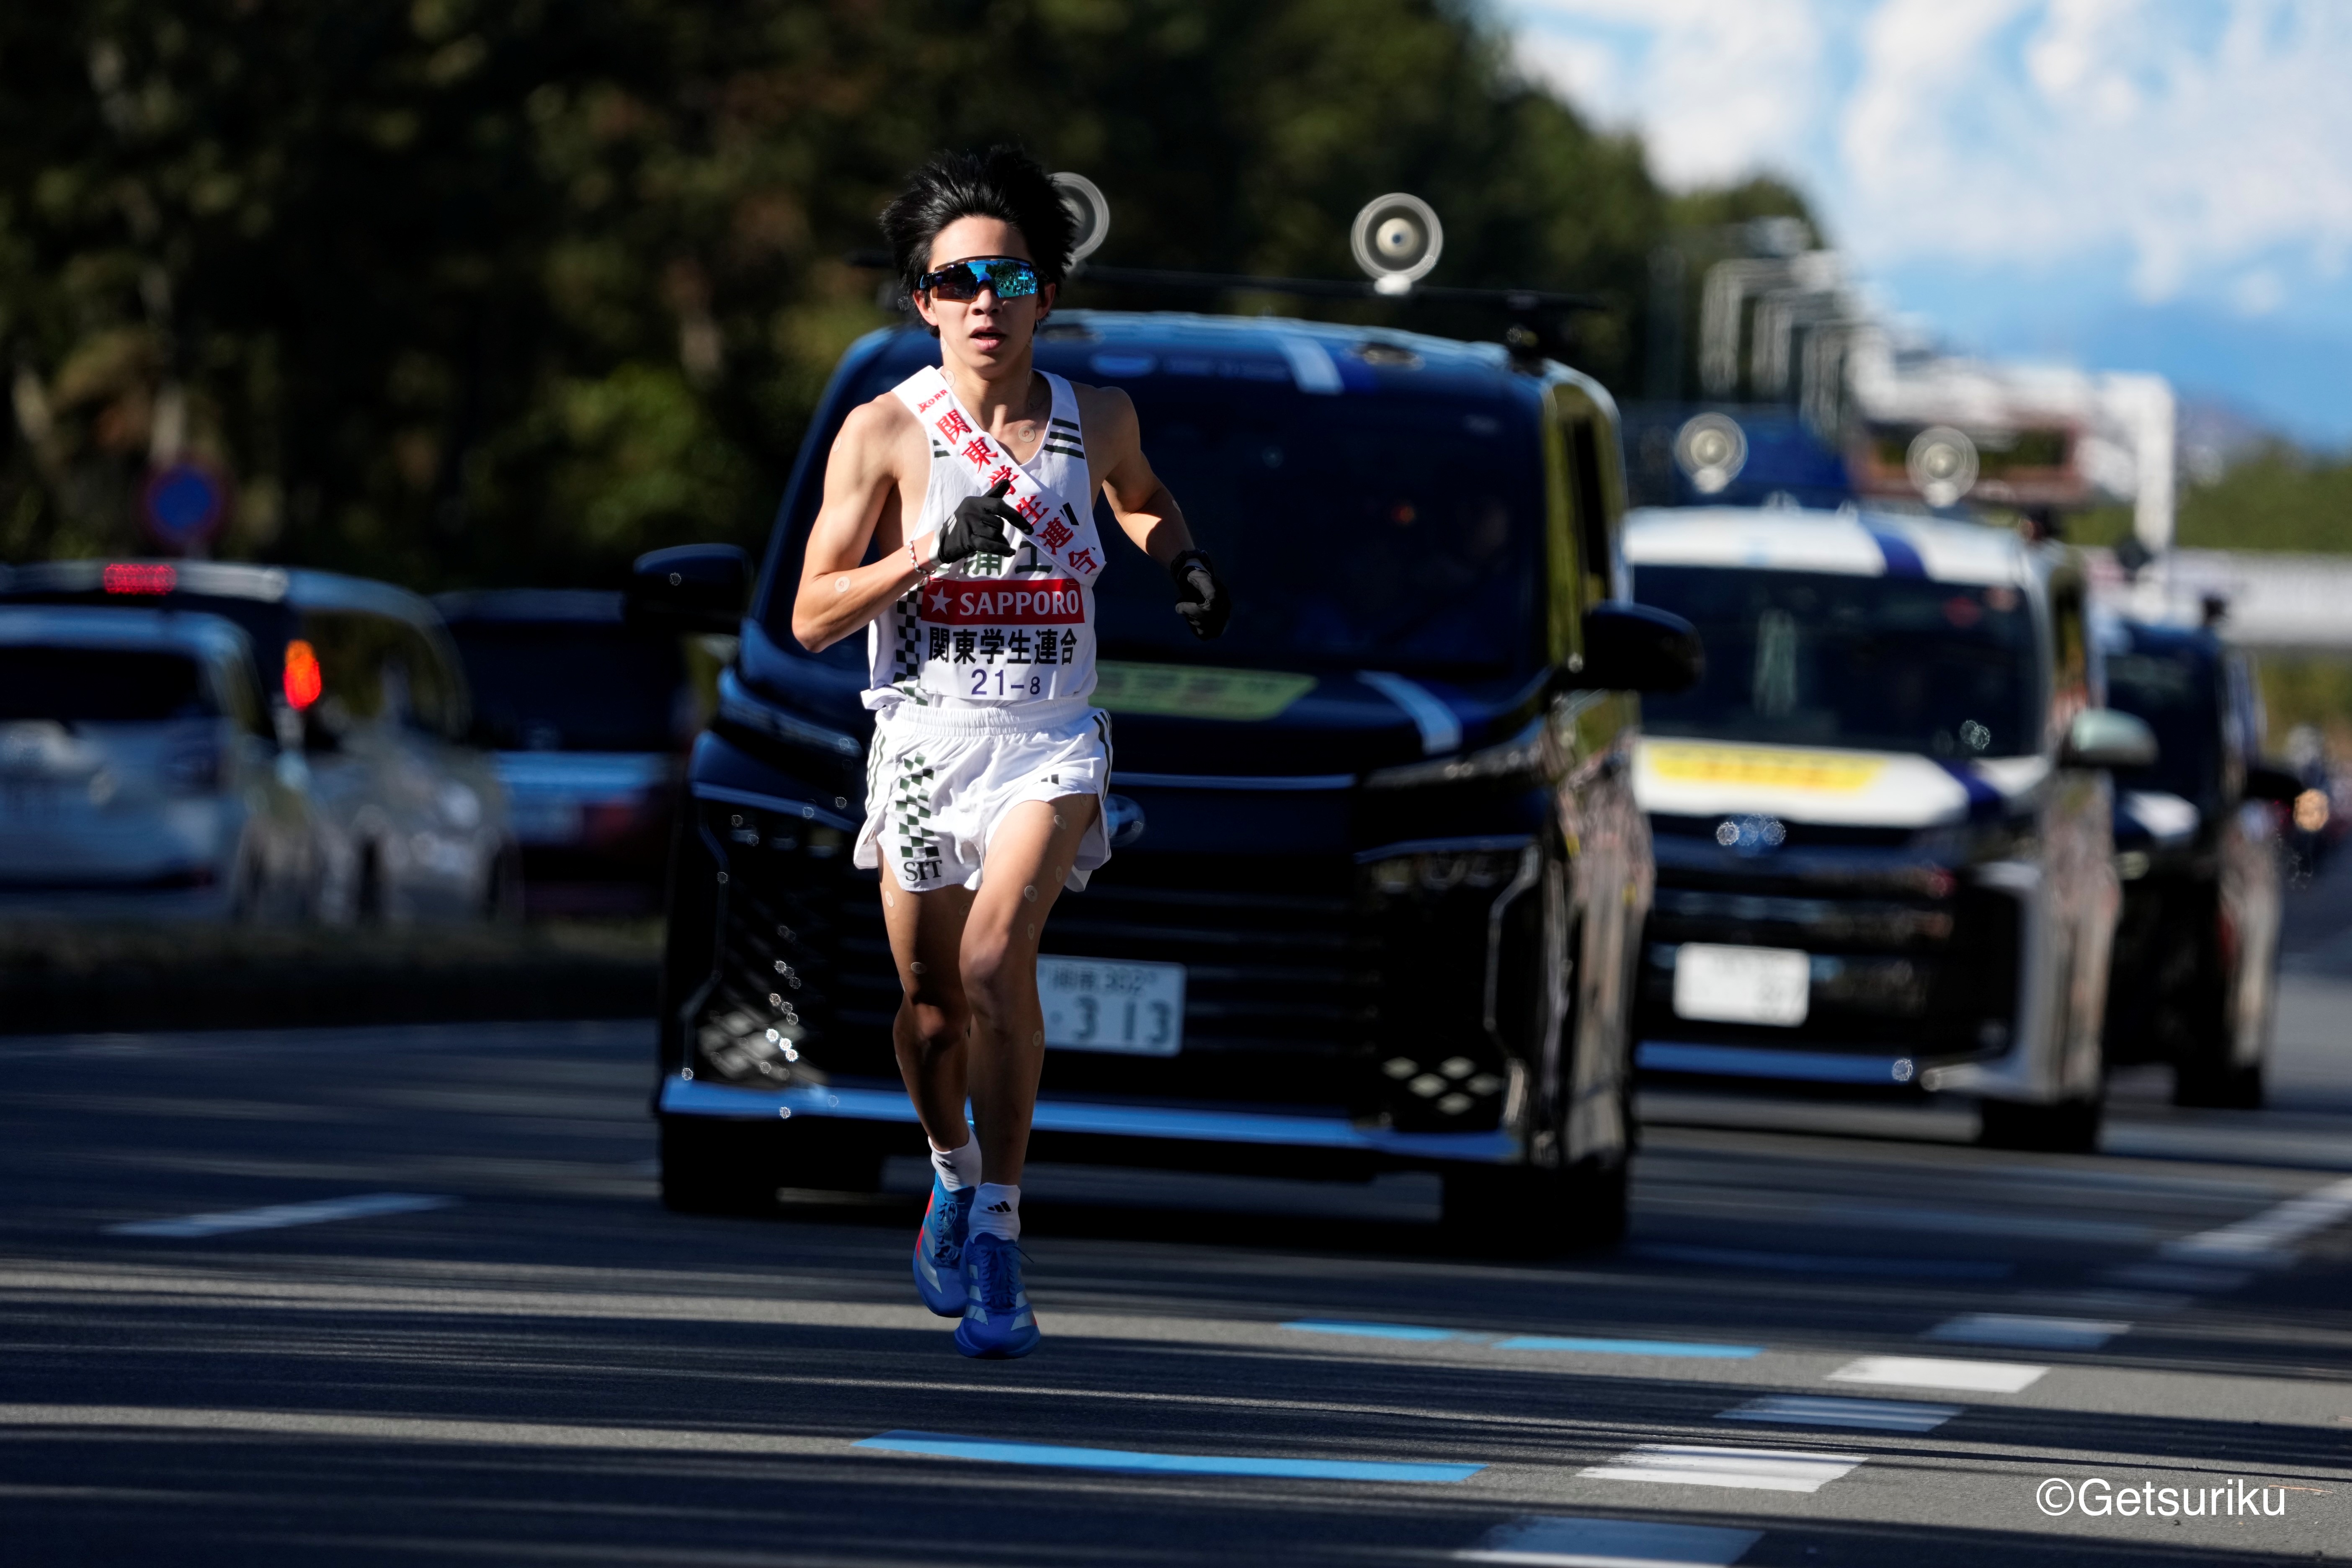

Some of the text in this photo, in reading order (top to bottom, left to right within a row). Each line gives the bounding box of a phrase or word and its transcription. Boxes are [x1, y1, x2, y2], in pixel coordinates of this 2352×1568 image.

[959, 589, 1079, 616] SAPPORO
[928, 627, 1078, 666] 関東学生連合
[904, 860, 942, 882] SIT
